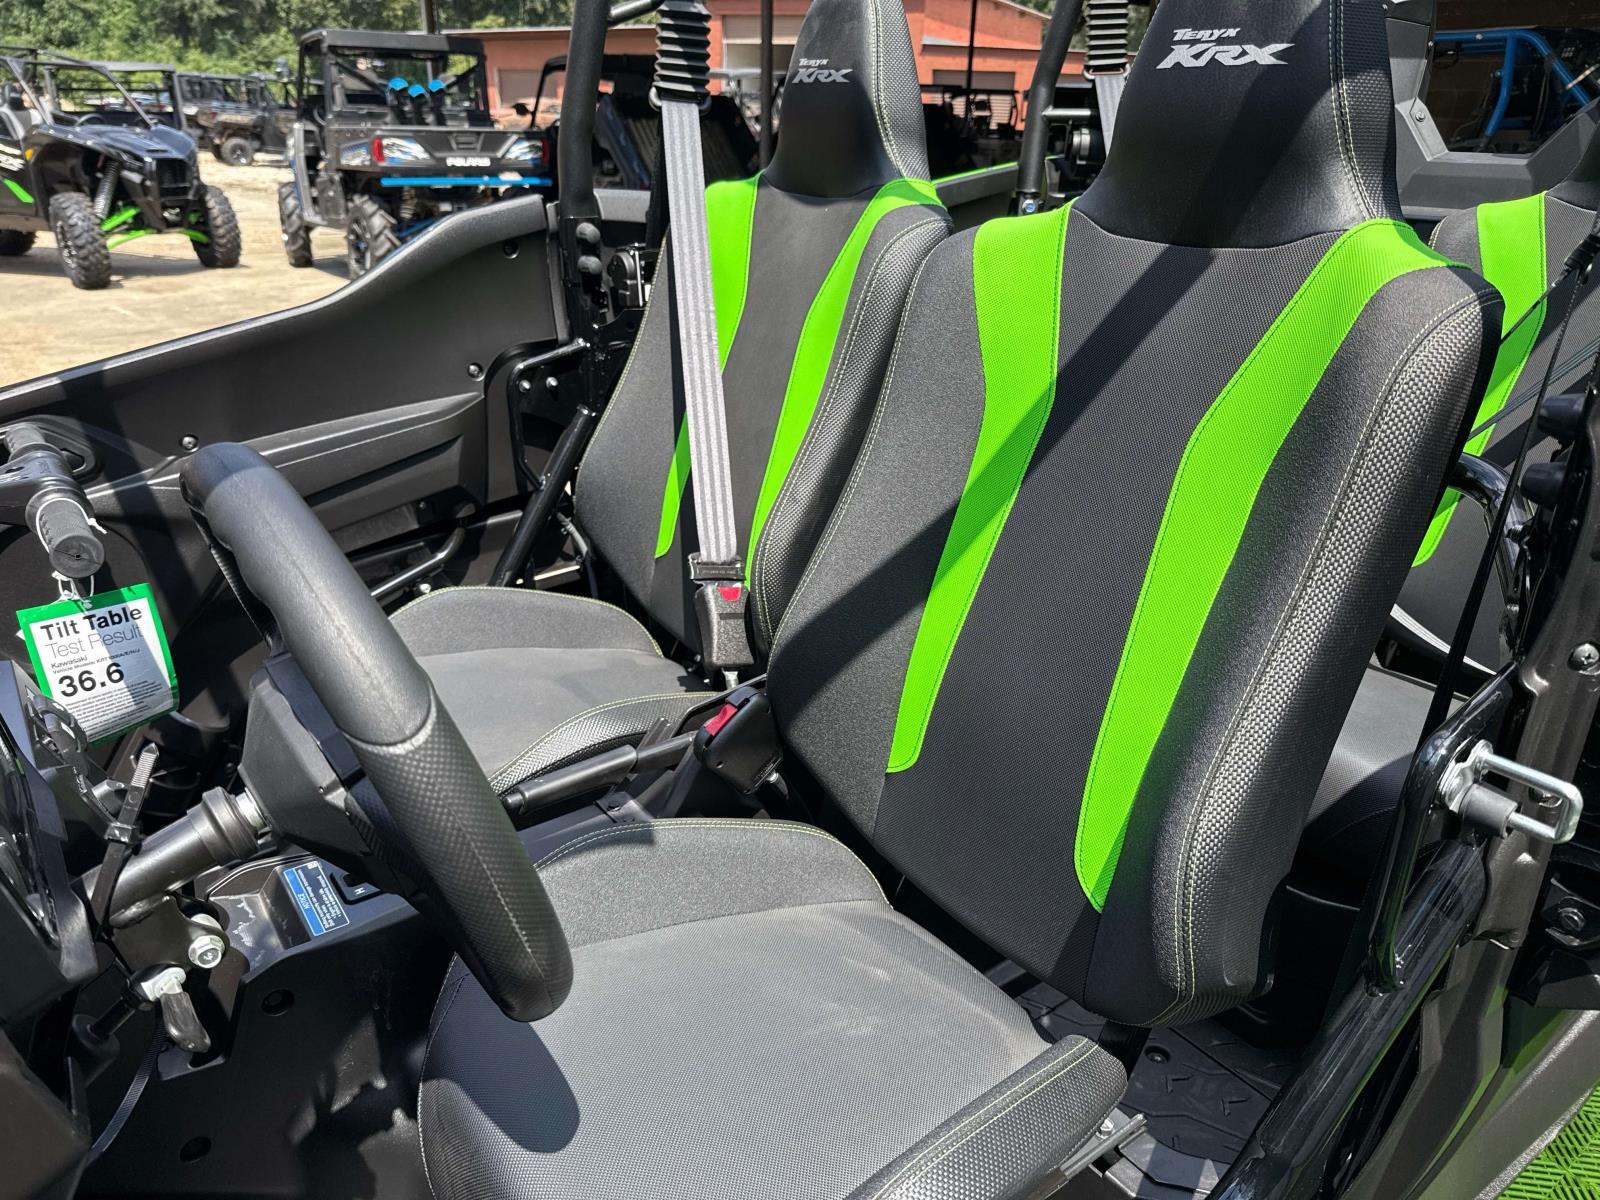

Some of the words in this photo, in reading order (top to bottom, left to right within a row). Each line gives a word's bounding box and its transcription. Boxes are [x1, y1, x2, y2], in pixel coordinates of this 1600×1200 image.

[1156, 42, 1296, 69] KRX
[792, 67, 854, 83] KRX
[40, 619, 80, 641] Tilt
[82, 607, 143, 631] Table
[45, 638, 85, 660] Test
[88, 626, 144, 651] Result
[50, 655, 88, 669] Kawasaki
[58, 662, 125, 697] 36.6
